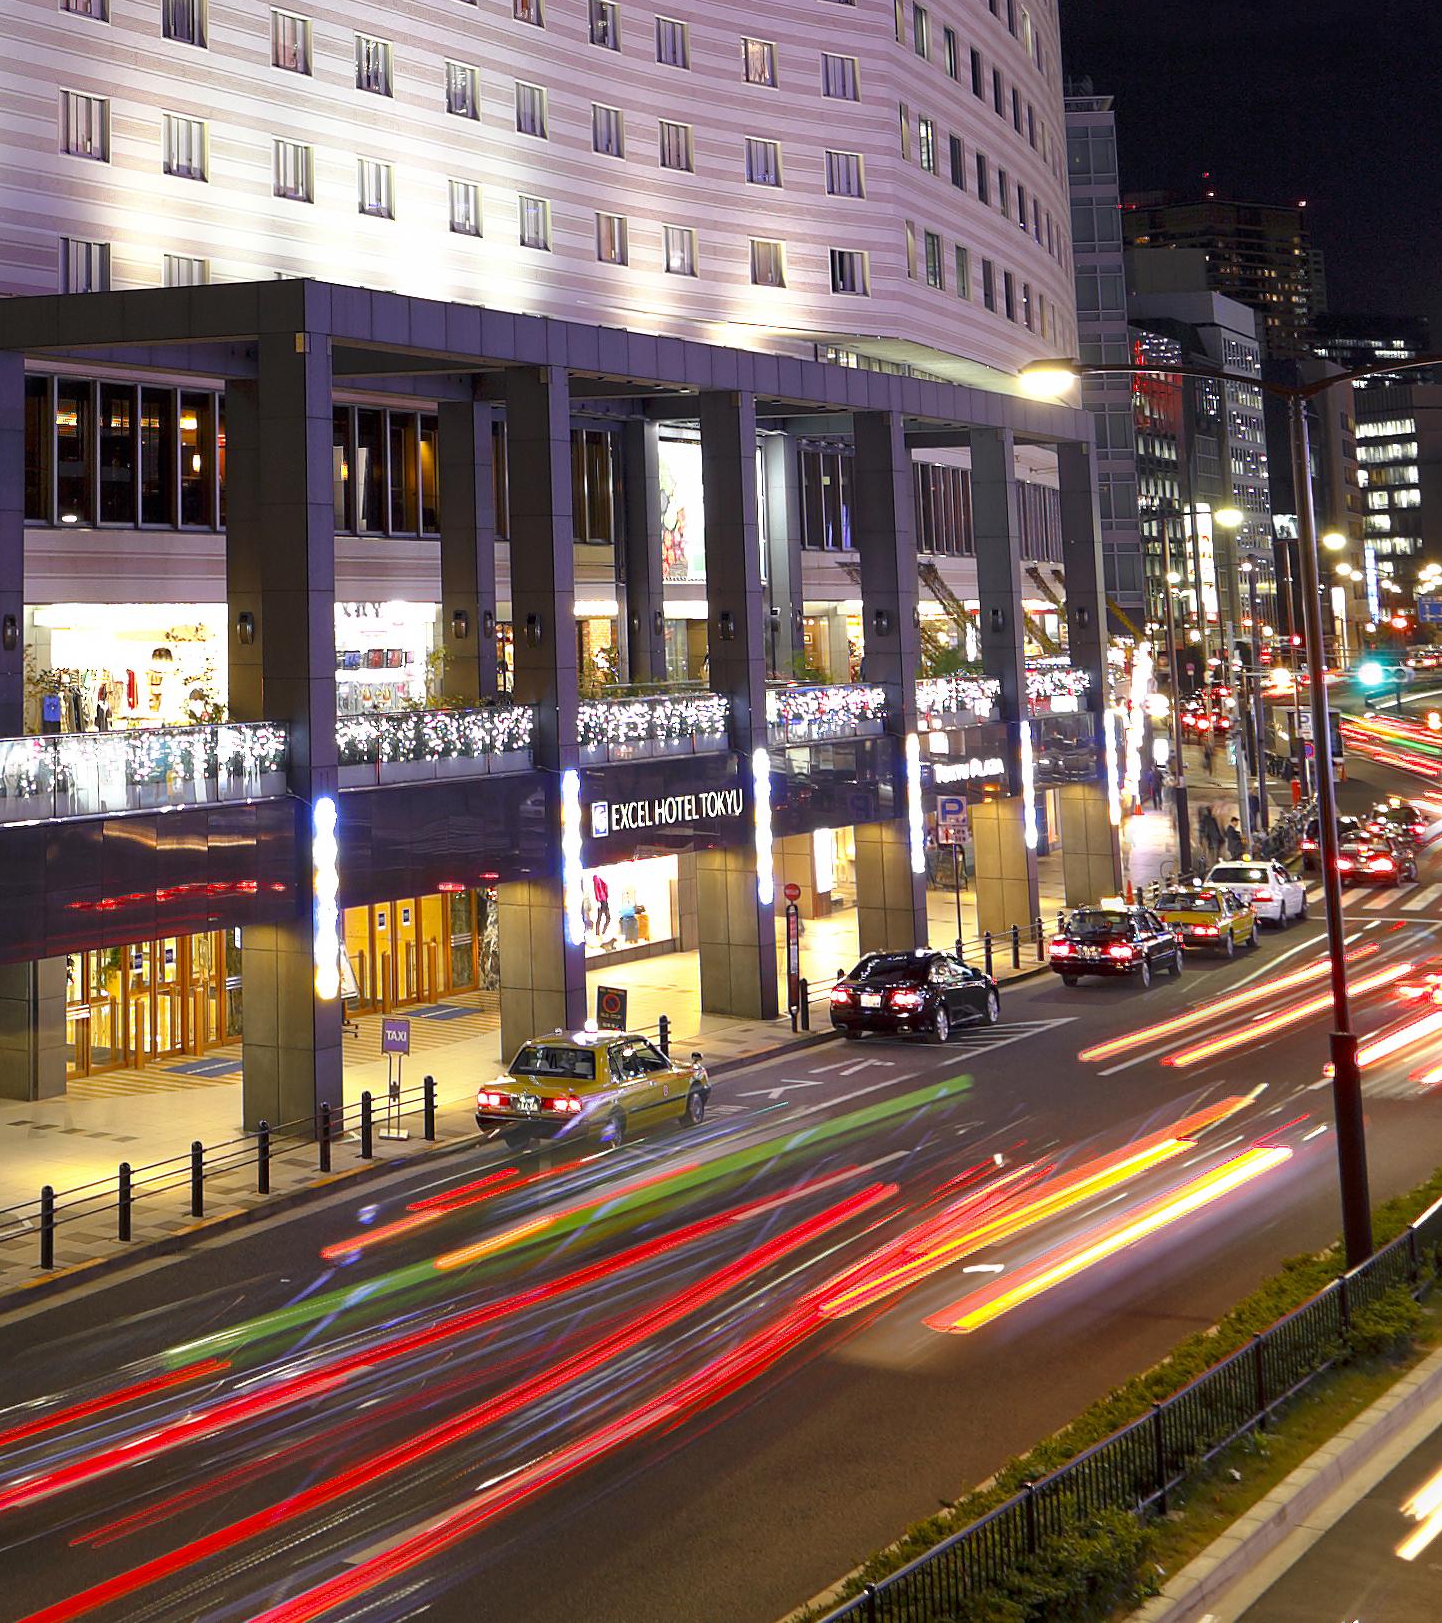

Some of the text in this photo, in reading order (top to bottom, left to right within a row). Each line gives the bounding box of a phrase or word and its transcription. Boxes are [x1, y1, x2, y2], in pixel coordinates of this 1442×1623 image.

[611, 788, 744, 831] EXCEL HOTEL TOKYU
[941, 798, 964, 823] P
[385, 1029, 407, 1042] TAXI
